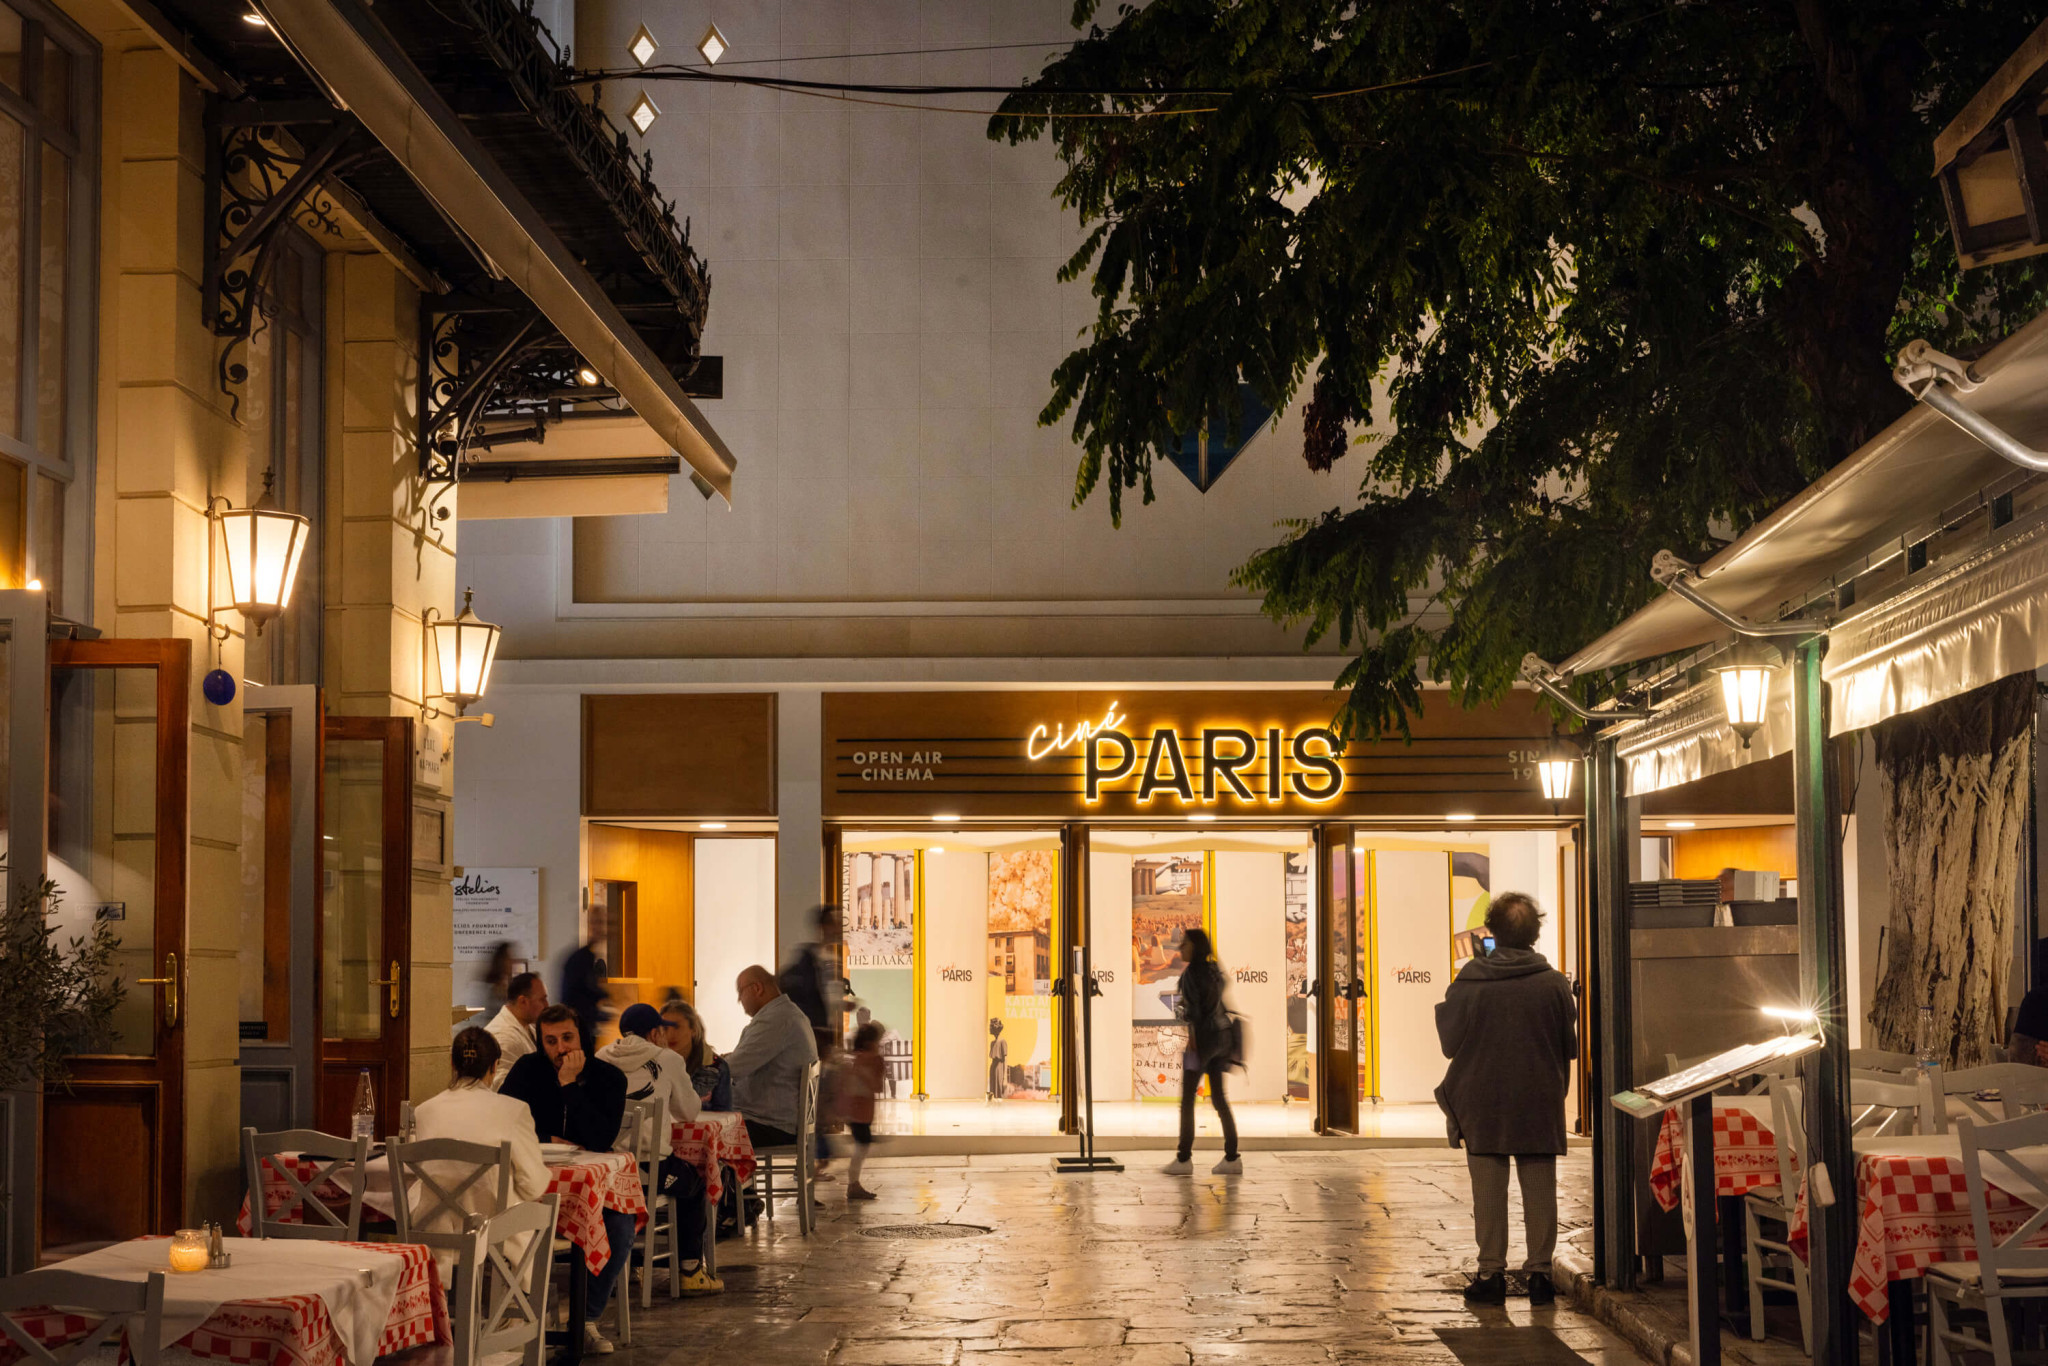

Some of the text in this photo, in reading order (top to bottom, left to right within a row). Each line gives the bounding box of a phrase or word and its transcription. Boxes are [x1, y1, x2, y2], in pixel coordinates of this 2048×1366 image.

[853, 751, 942, 764] OPEN AIR
[1508, 750, 1541, 763] SIN
[1084, 728, 1344, 804] PARIS
[861, 768, 934, 781] CINEMA
[1512, 767, 1534, 780] 19
[942, 969, 973, 982] PARIS
[1091, 970, 1115, 983] ARIS
[1236, 970, 1268, 983] PARIS
[1397, 970, 1432, 983] PARIS
